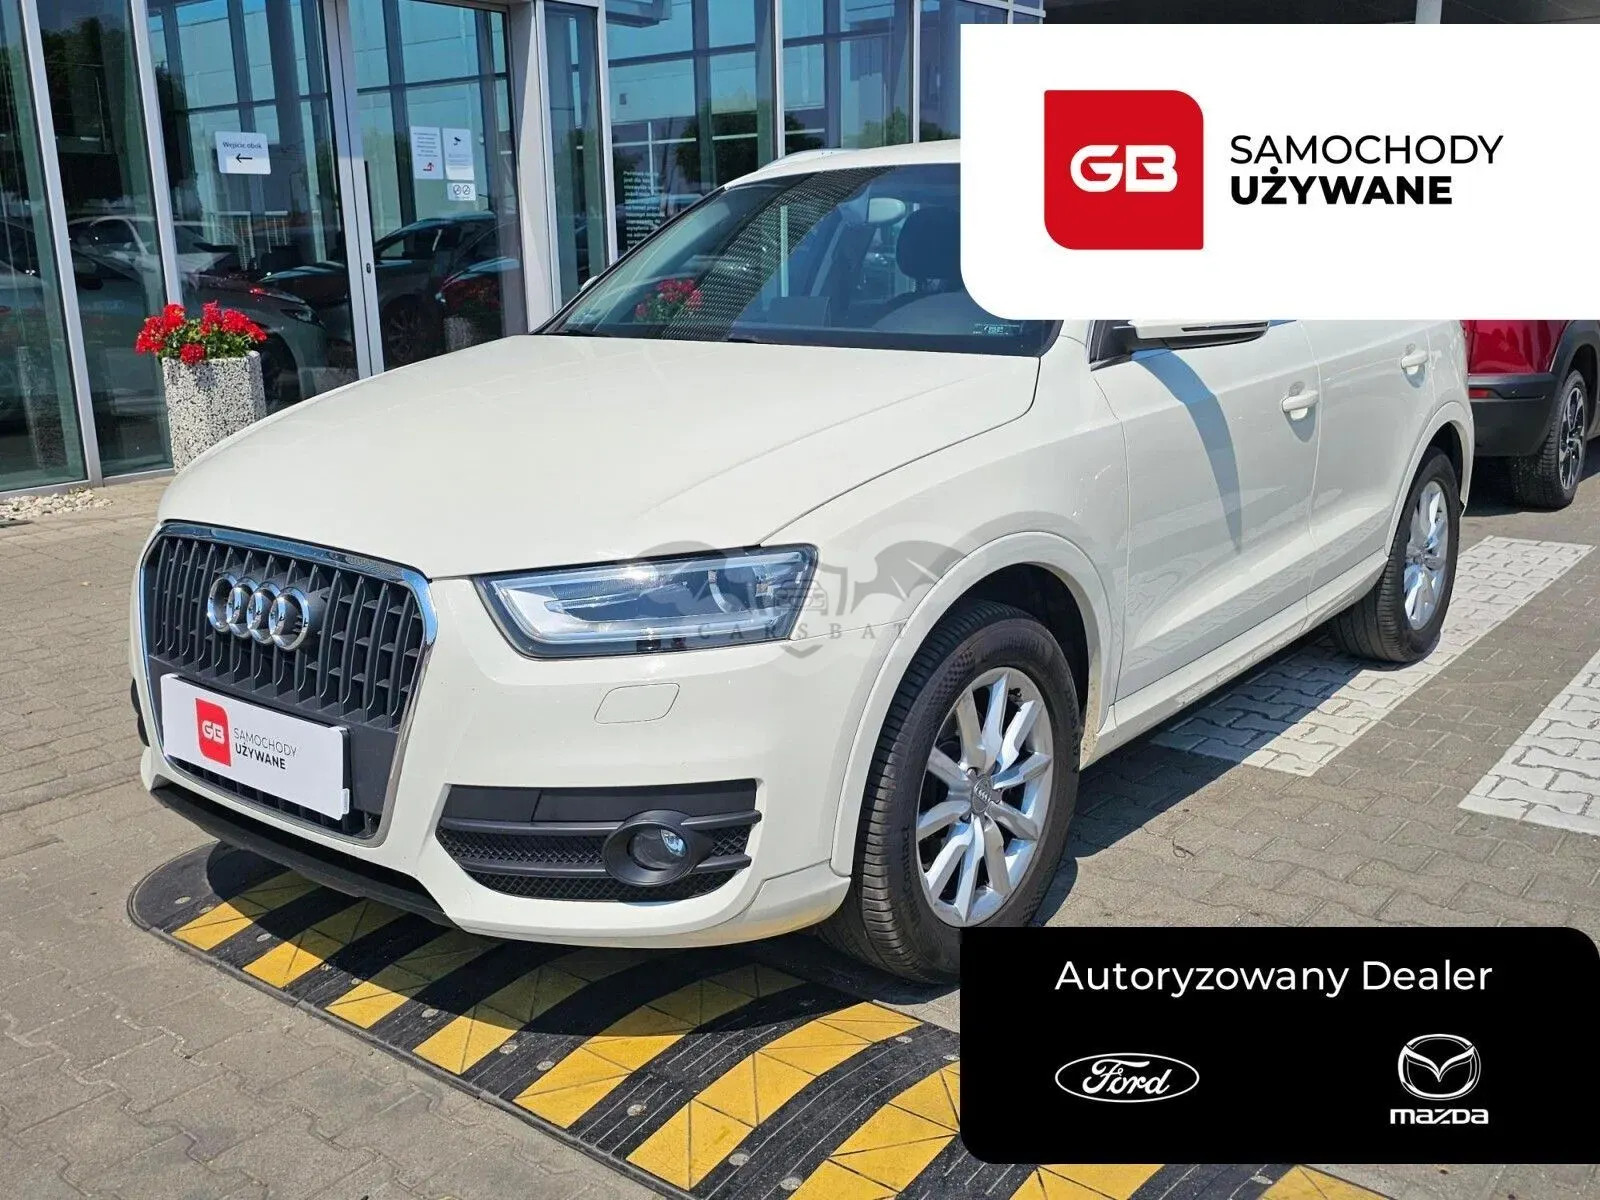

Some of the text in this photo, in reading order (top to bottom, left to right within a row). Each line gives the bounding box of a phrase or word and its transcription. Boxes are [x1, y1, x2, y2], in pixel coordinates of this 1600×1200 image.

[202, 720, 225, 744] GB
[233, 727, 297, 757] SAMOCHODY
[235, 742, 286, 770] UŻYWANE
